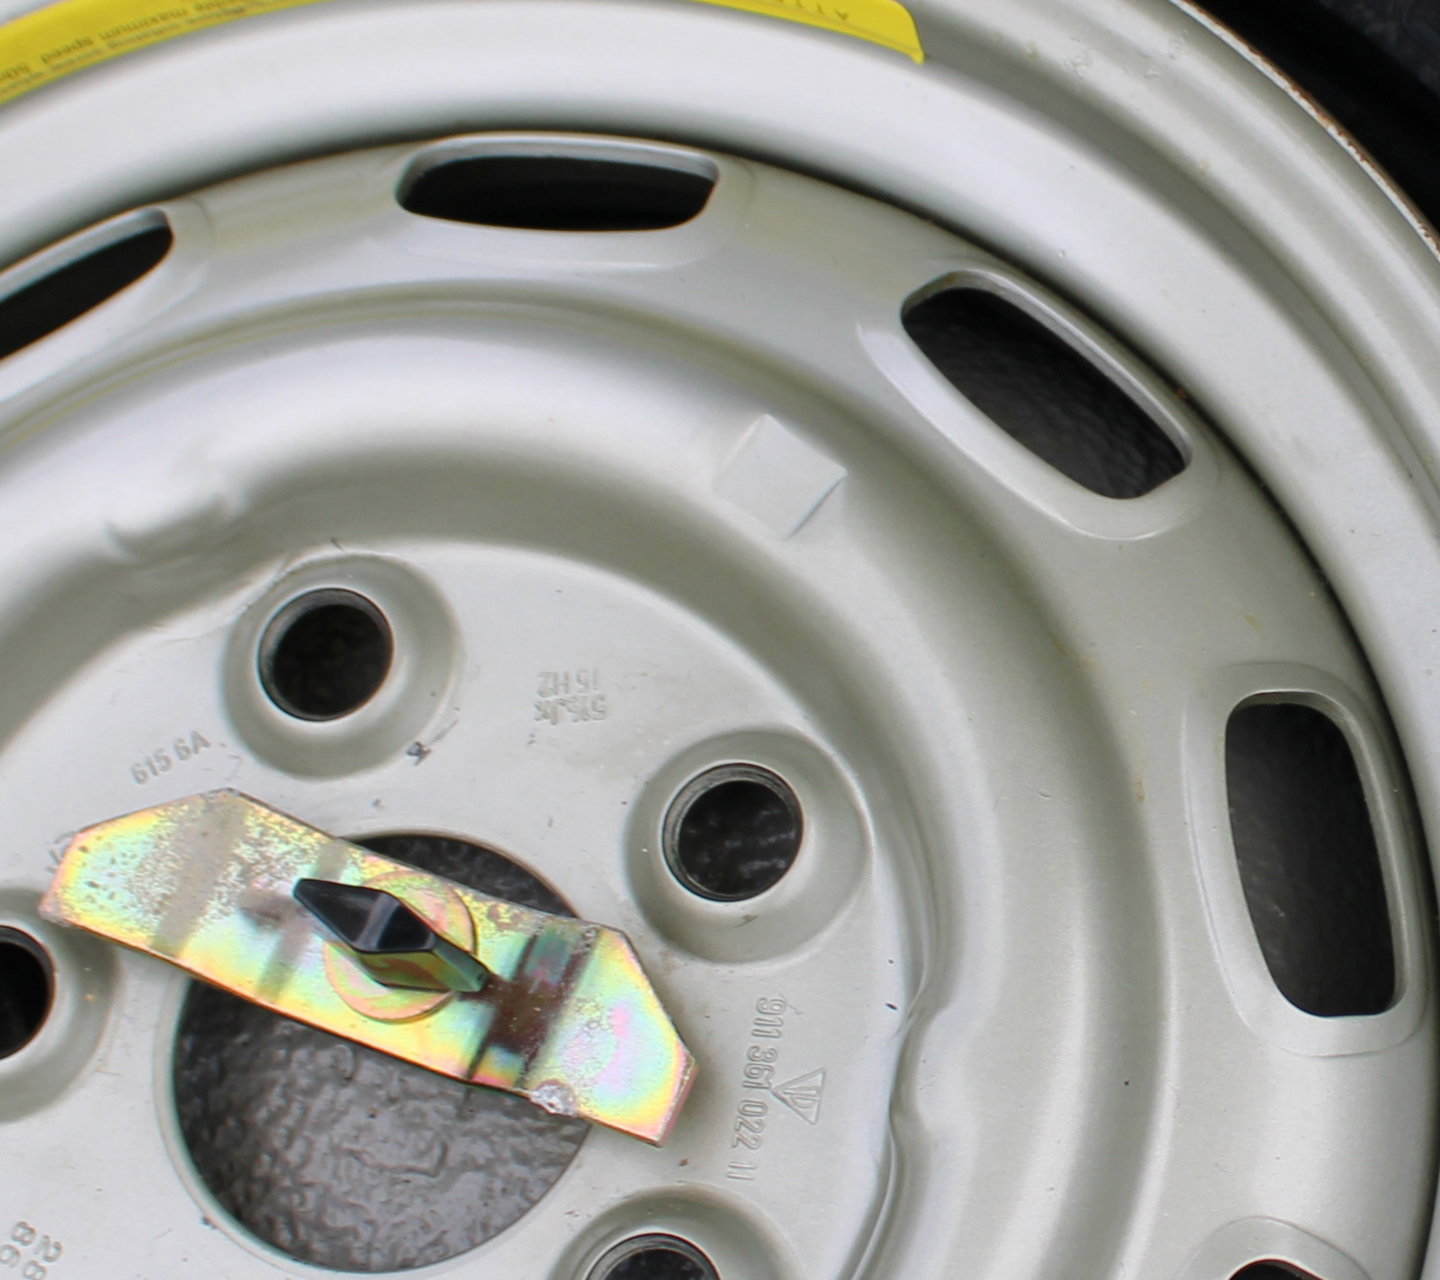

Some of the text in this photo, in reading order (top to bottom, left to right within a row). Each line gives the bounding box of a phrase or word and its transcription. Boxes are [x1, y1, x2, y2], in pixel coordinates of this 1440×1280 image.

[96, 4, 189, 45] maximum
[39, 31, 95, 67] speed
[749, 992, 787, 1039] 911
[741, 1041, 776, 1090] 361
[731, 1096, 767, 1150] 022
